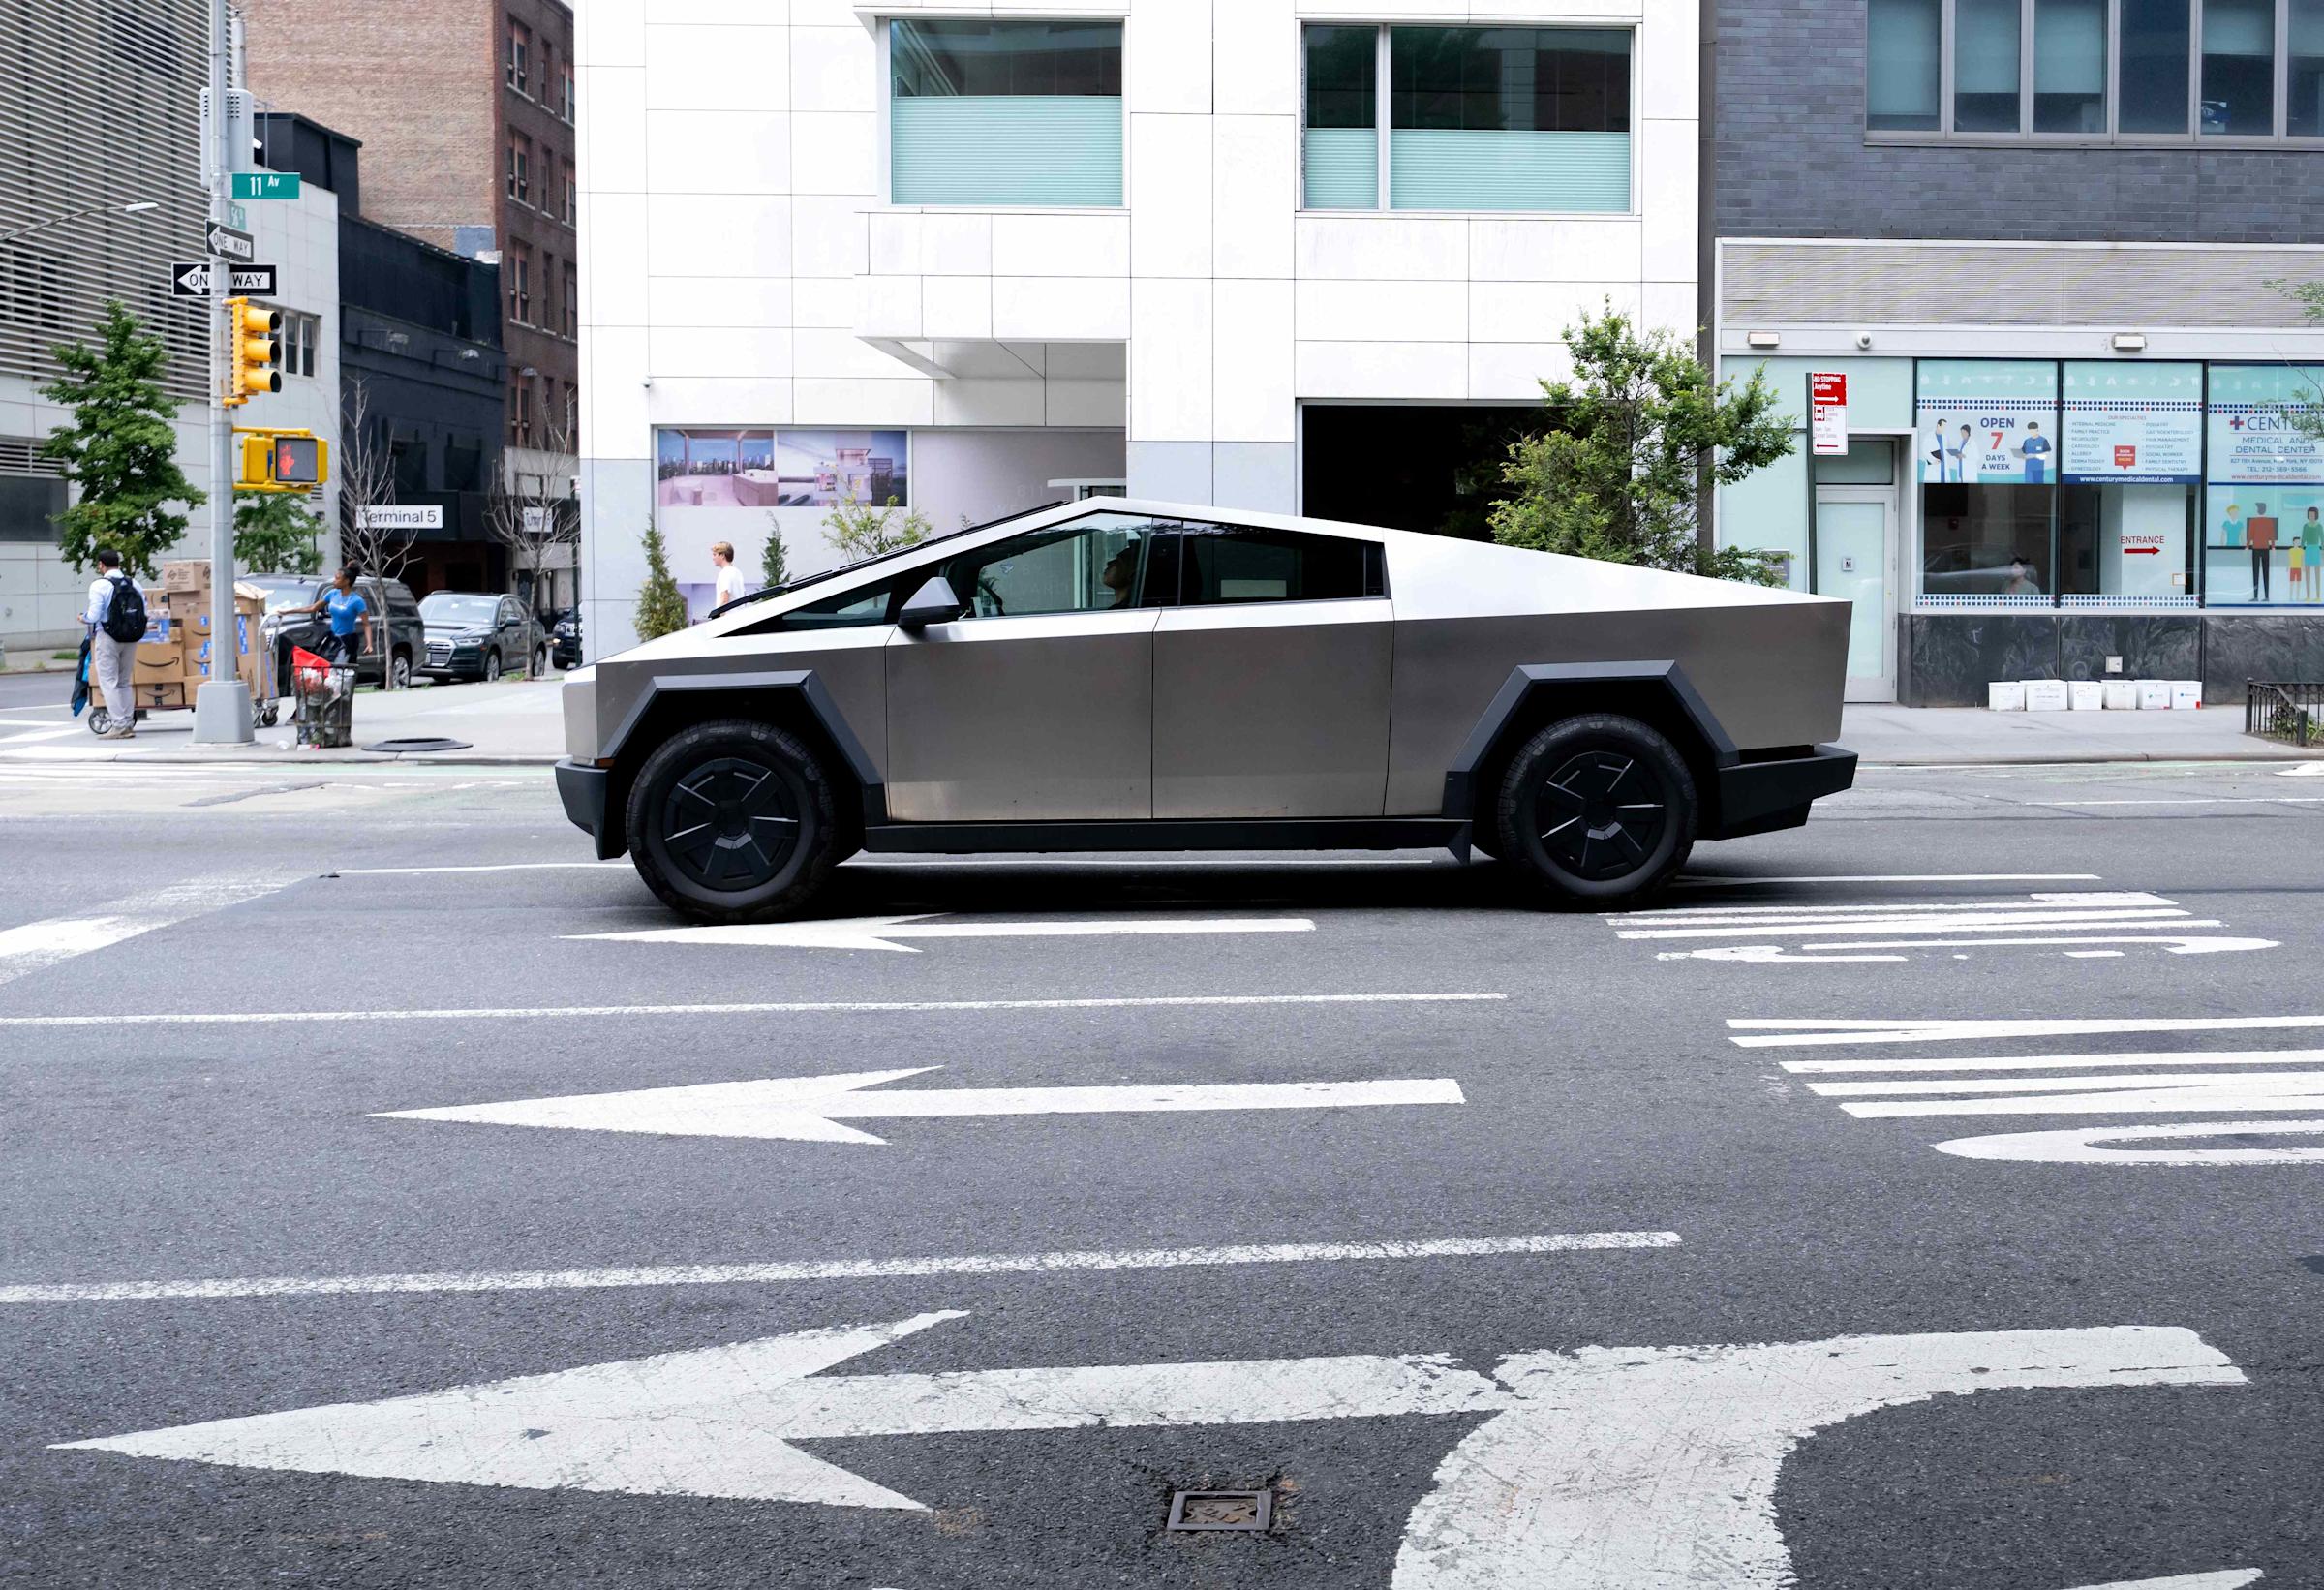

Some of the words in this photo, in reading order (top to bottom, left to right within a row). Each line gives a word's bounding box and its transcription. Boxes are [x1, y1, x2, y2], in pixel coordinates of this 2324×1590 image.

[250, 176, 262, 196] 11
[267, 175, 280, 187] Av
[214, 232, 228, 248] ONE
[233, 239, 249, 254] WAY
[189, 274, 209, 287] ON
[232, 274, 263, 287] WAY
[1980, 417, 2015, 428] OPEN
[1990, 432, 2003, 450] 7
[427, 510, 437, 523] 5
[2120, 535, 2165, 544] ENTRANCE
